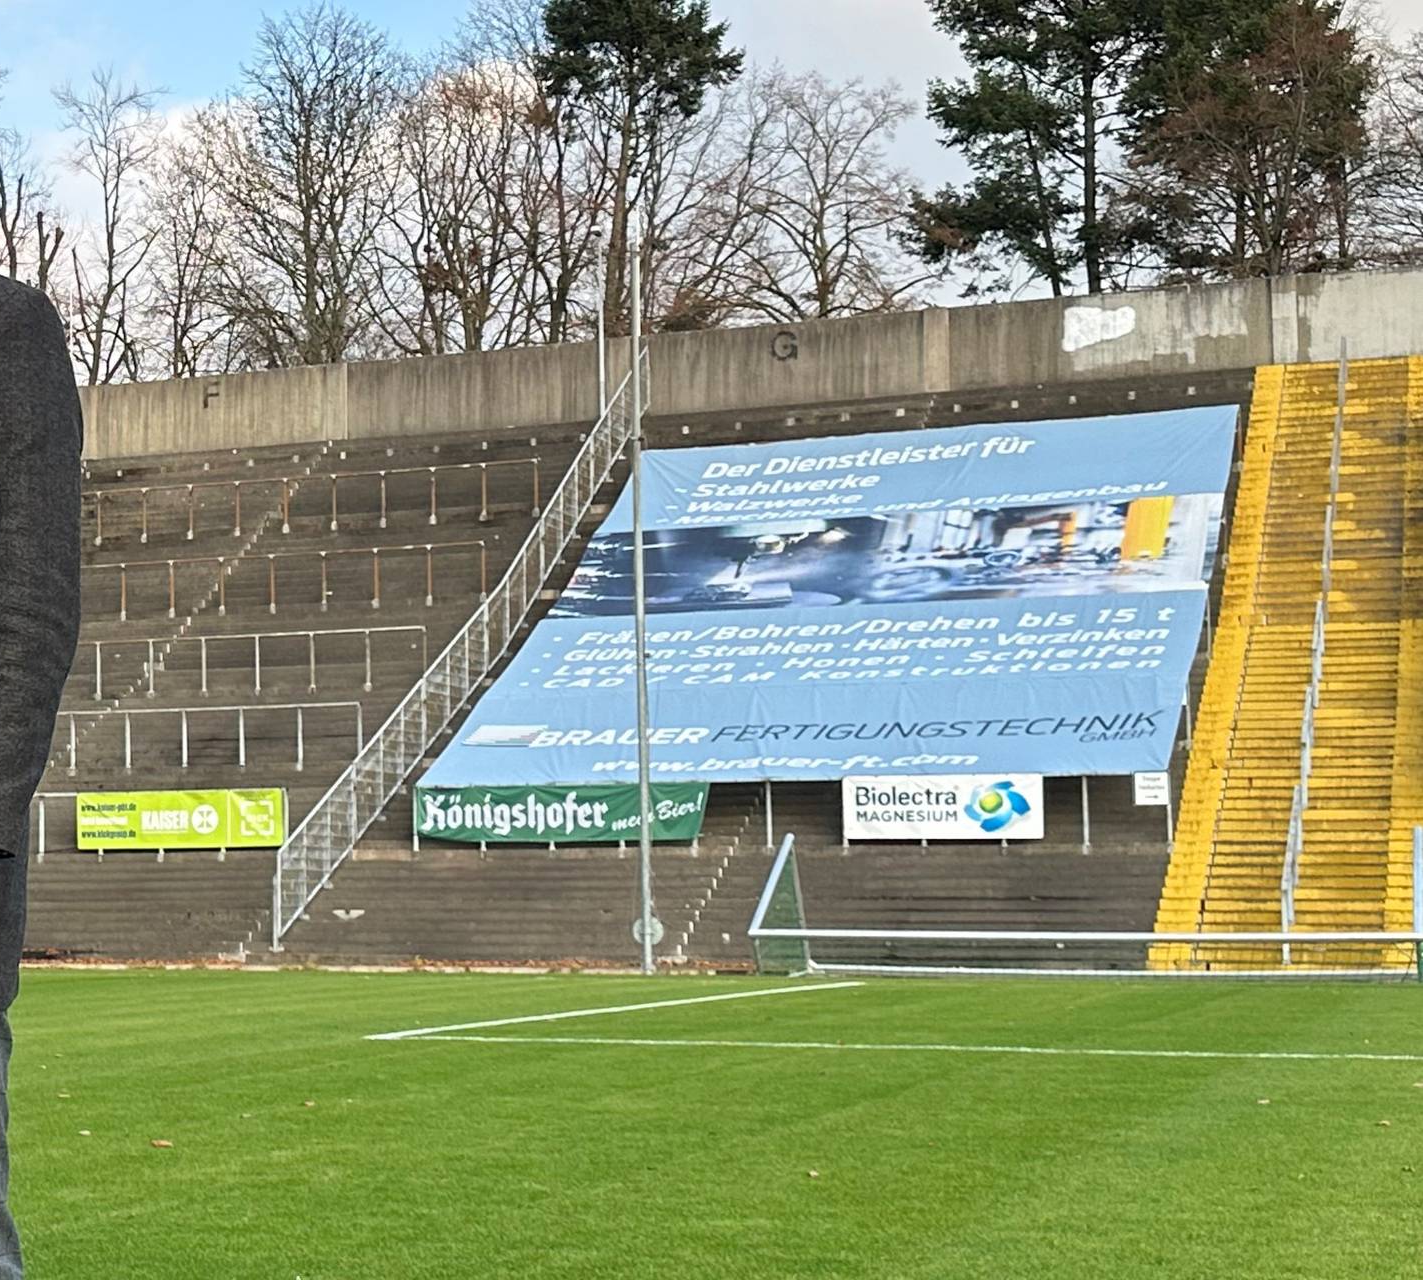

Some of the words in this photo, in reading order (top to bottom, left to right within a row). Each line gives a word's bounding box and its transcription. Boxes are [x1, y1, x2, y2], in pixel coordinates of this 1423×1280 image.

[773, 331, 798, 361] G
[203, 381, 221, 409] F
[701, 461, 762, 480] Der
[762, 439, 978, 477] Dienstleister
[980, 436, 1036, 459] für
[690, 473, 882, 498] Stahlwerke
[872, 497, 945, 512] und
[944, 480, 1169, 507] Anlagenbau
[686, 493, 864, 514] Walzwerke
[1017, 611, 1077, 629] bis
[1096, 607, 1138, 624] 15
[1157, 606, 1176, 622] t
[997, 627, 1171, 647] Verzinken
[781, 653, 911, 669] Honen
[962, 644, 1167, 664] Schleifen
[542, 676, 626, 689] CAD
[681, 670, 776, 685] CAM
[798, 658, 1162, 681] Konstruktionen
[527, 726, 710, 749] BRAUER
[710, 708, 1165, 744] FERTIGUNGSTECHNIK
[1079, 727, 1157, 744] GMBH
[591, 752, 979, 774] www.brauer-ft.com
[855, 785, 958, 807] Biolectra
[141, 810, 188, 831] KAISER
[421, 790, 609, 836] Königshofer
[655, 791, 704, 821] Bier!
[856, 809, 959, 823] MAGNESIUM
